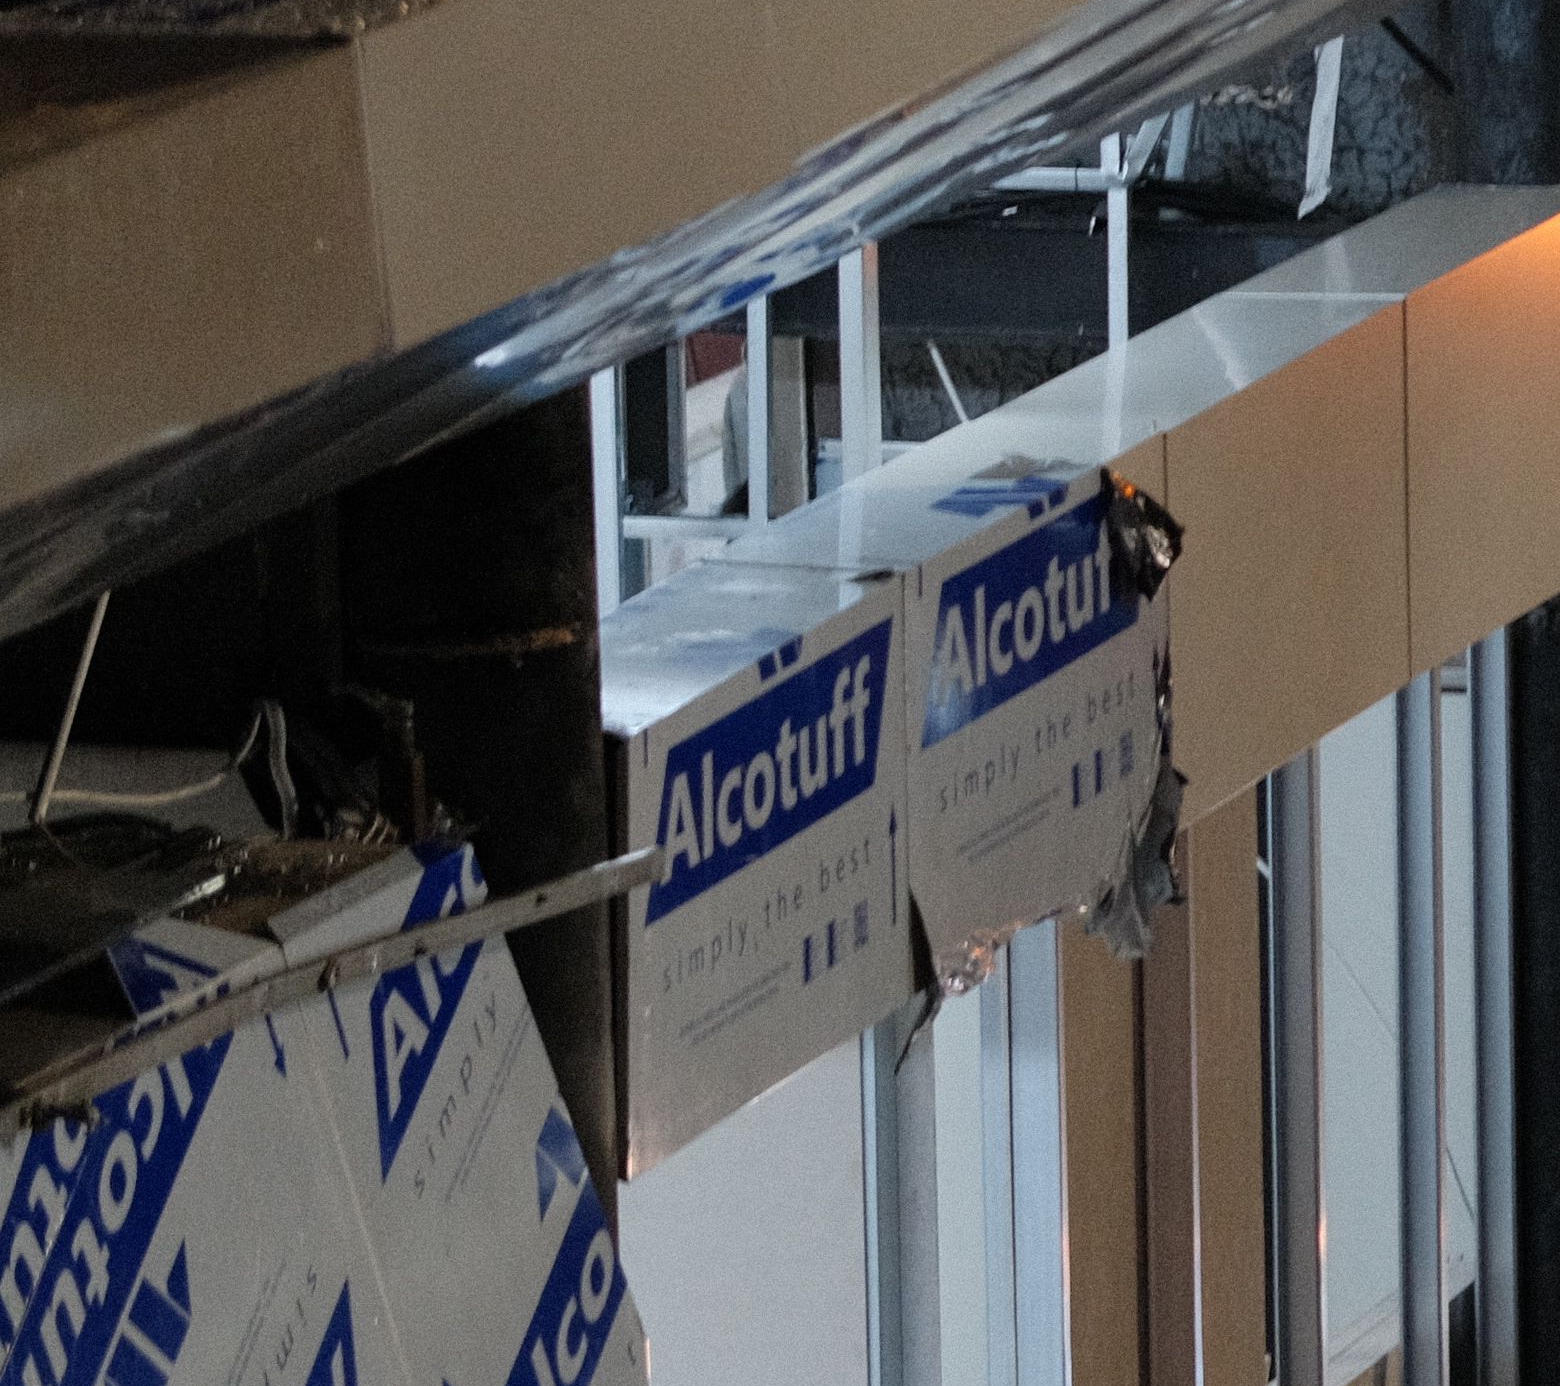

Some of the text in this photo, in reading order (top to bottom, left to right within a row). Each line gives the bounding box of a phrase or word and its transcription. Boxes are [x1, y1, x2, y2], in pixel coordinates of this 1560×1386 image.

[660, 654, 871, 885] Alcotuff
[939, 671, 1136, 811] simply the best
[662, 838, 871, 993] simply the best
